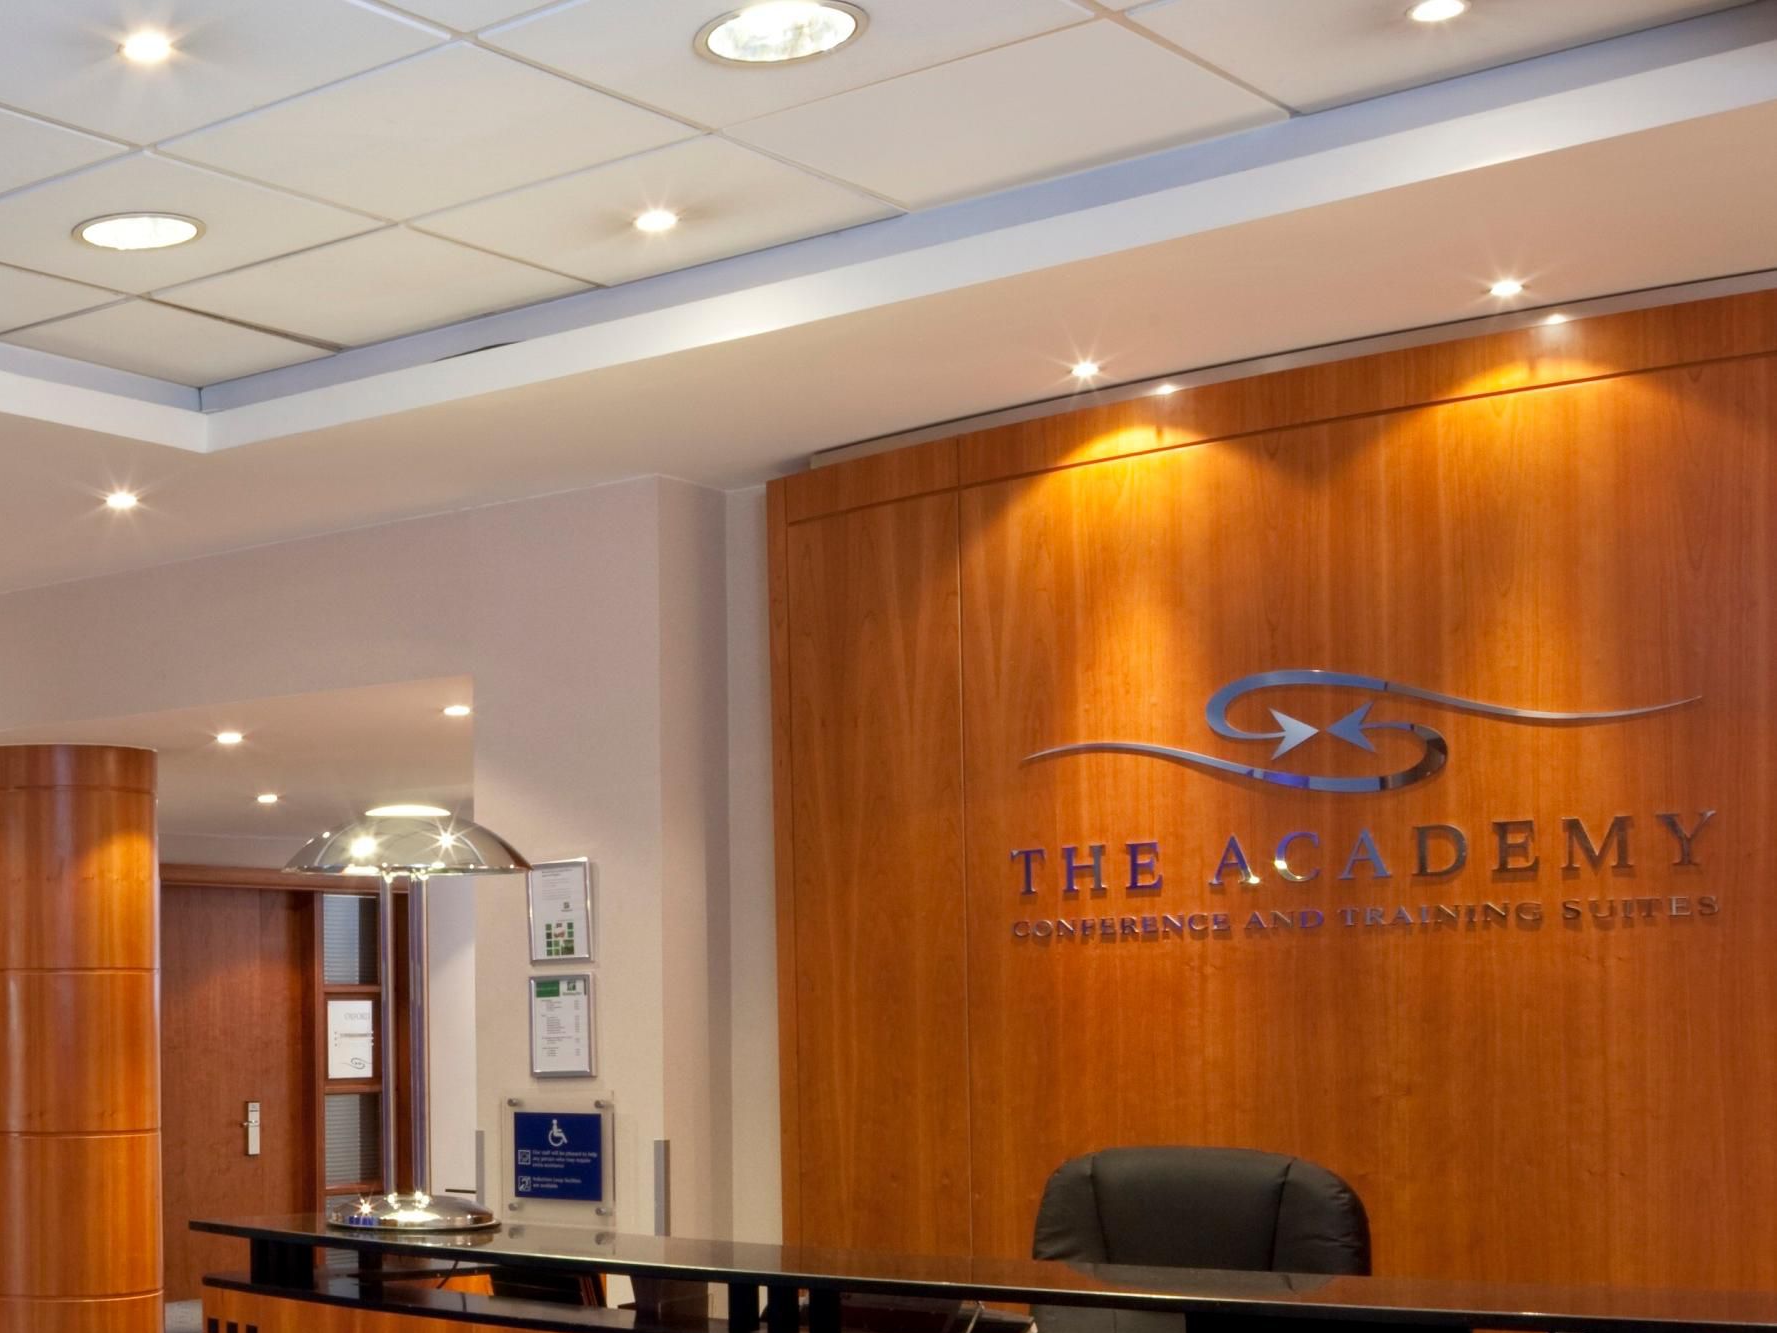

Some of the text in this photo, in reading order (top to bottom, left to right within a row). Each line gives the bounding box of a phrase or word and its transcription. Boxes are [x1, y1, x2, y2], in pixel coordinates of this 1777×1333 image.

[1010, 810, 1716, 895] THE ACADEMY
[1012, 895, 1719, 938] CONFERENCE AND TRAINING SUITES
